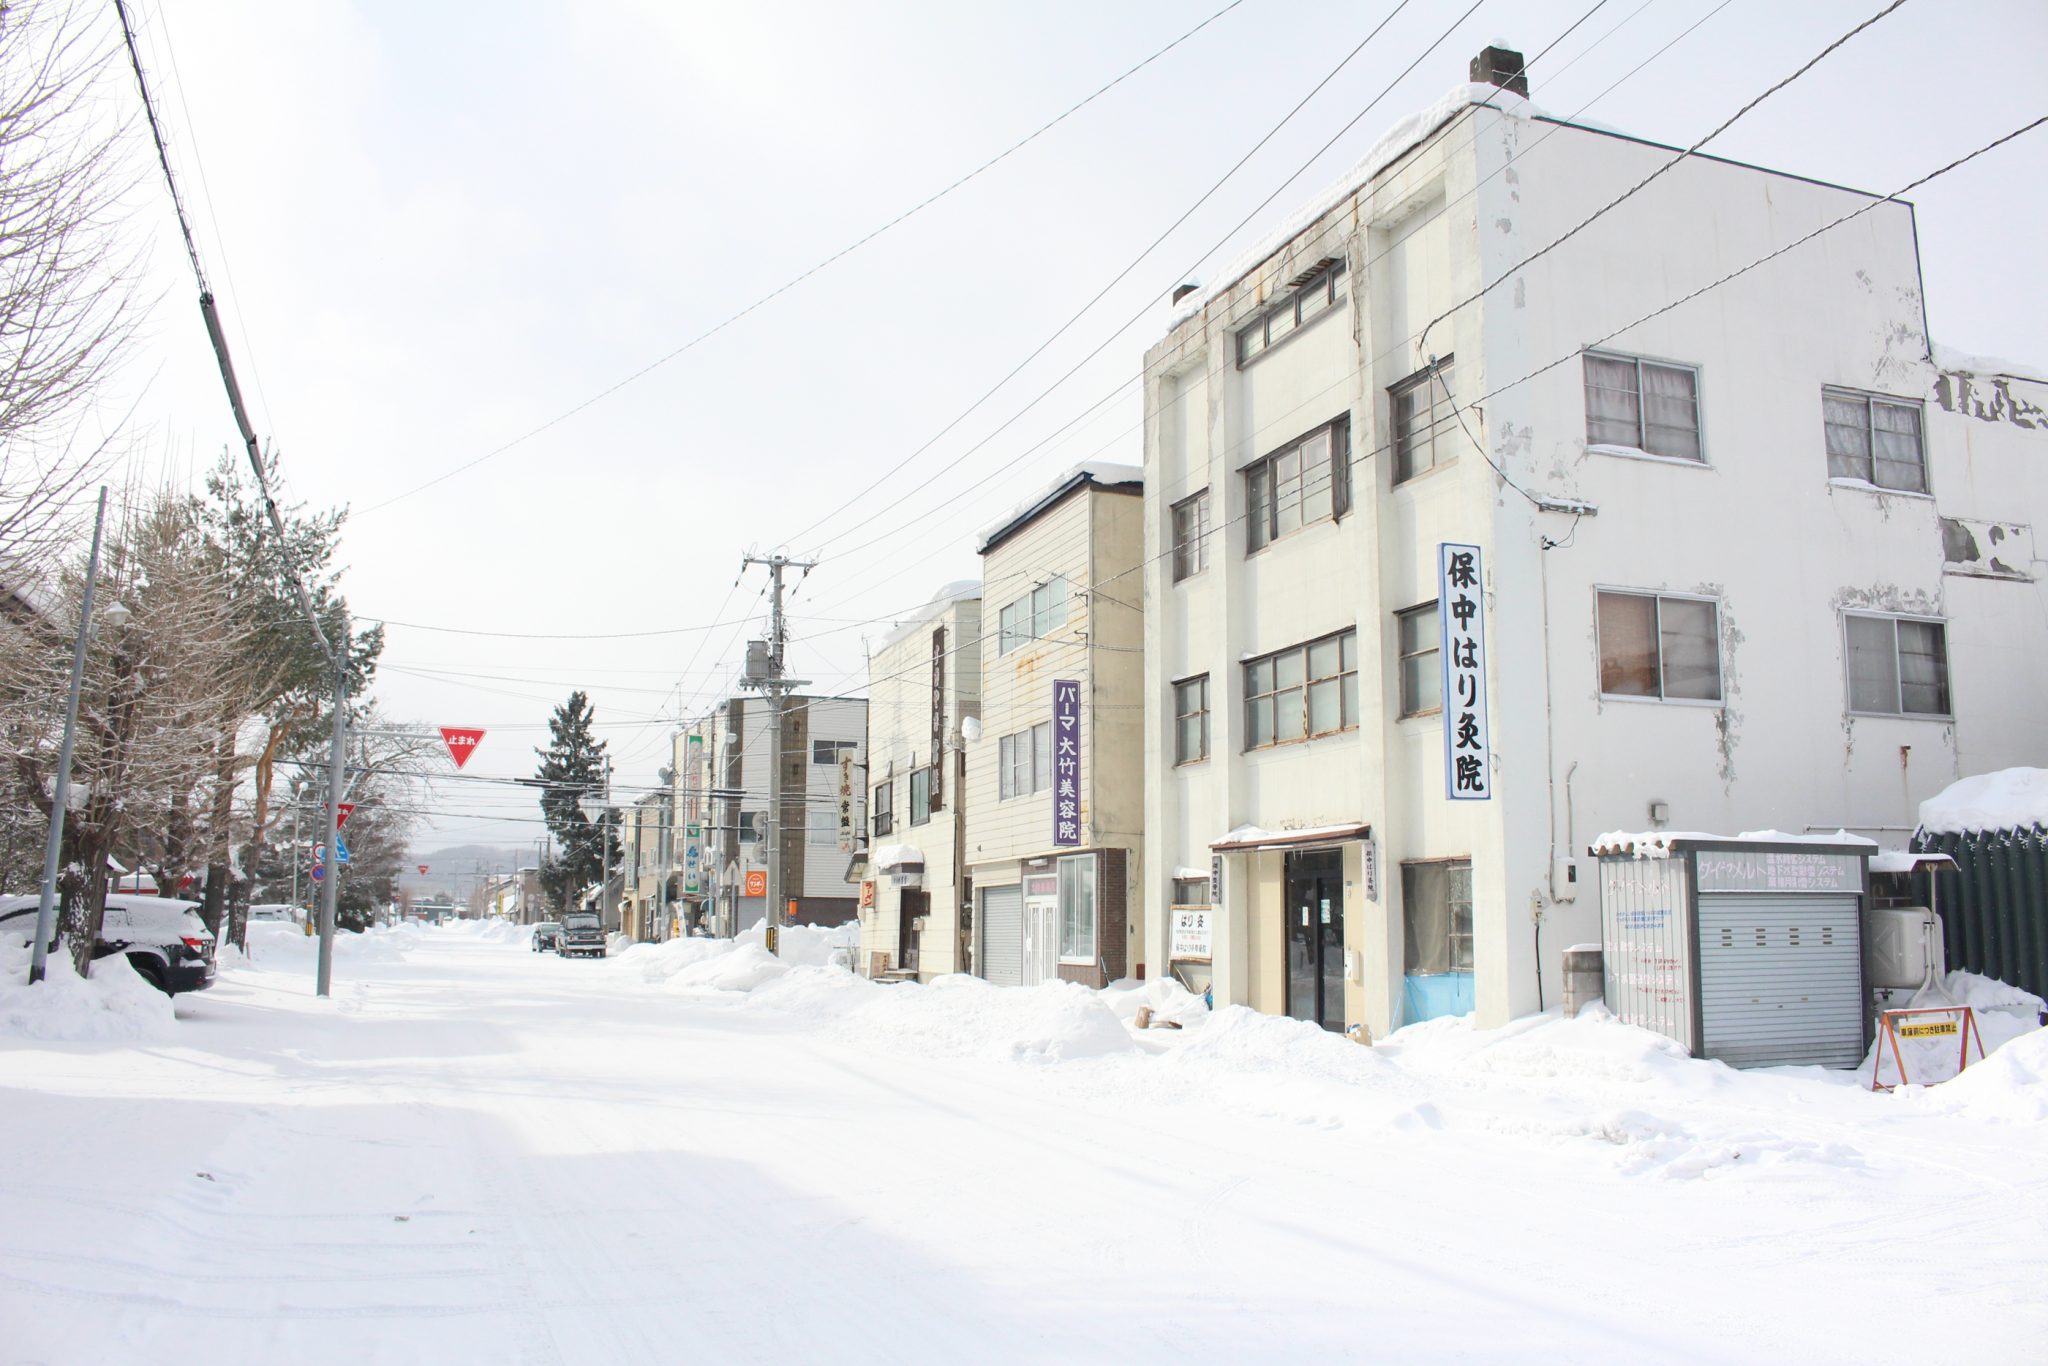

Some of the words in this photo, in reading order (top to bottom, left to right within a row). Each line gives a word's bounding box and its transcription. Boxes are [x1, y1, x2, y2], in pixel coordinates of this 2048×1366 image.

[1448, 551, 1484, 792] 保中はり灸院
[448, 735, 476, 746] 止まれ
[863, 882, 873, 906] ラーメン
